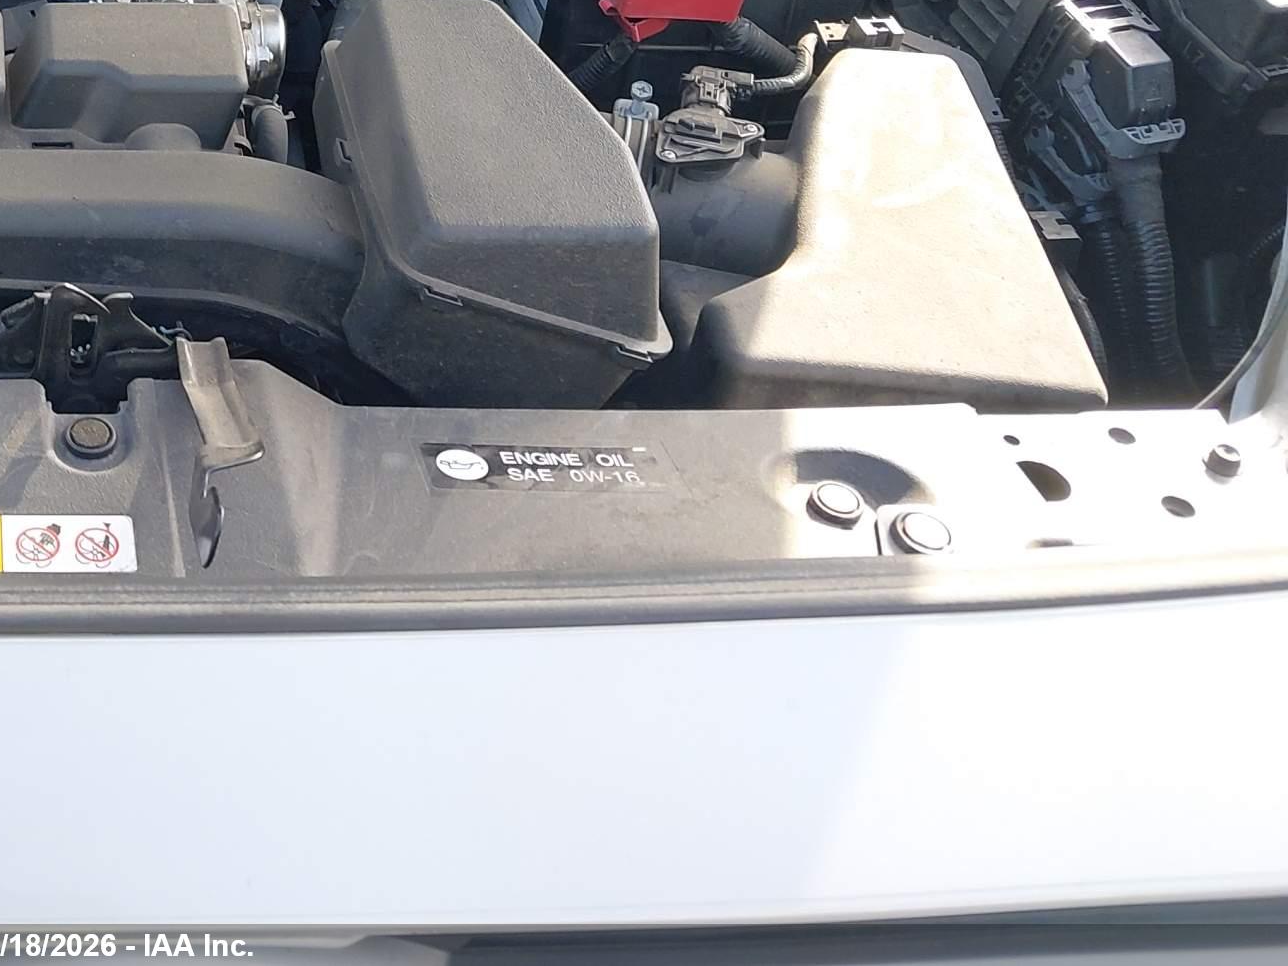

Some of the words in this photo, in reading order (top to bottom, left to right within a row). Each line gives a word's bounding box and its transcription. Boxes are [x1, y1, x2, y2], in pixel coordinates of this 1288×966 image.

[499, 451, 583, 466] ENGINE
[595, 454, 634, 467] OIL
[506, 467, 555, 482] SAE
[569, 470, 640, 483] 0W-16
